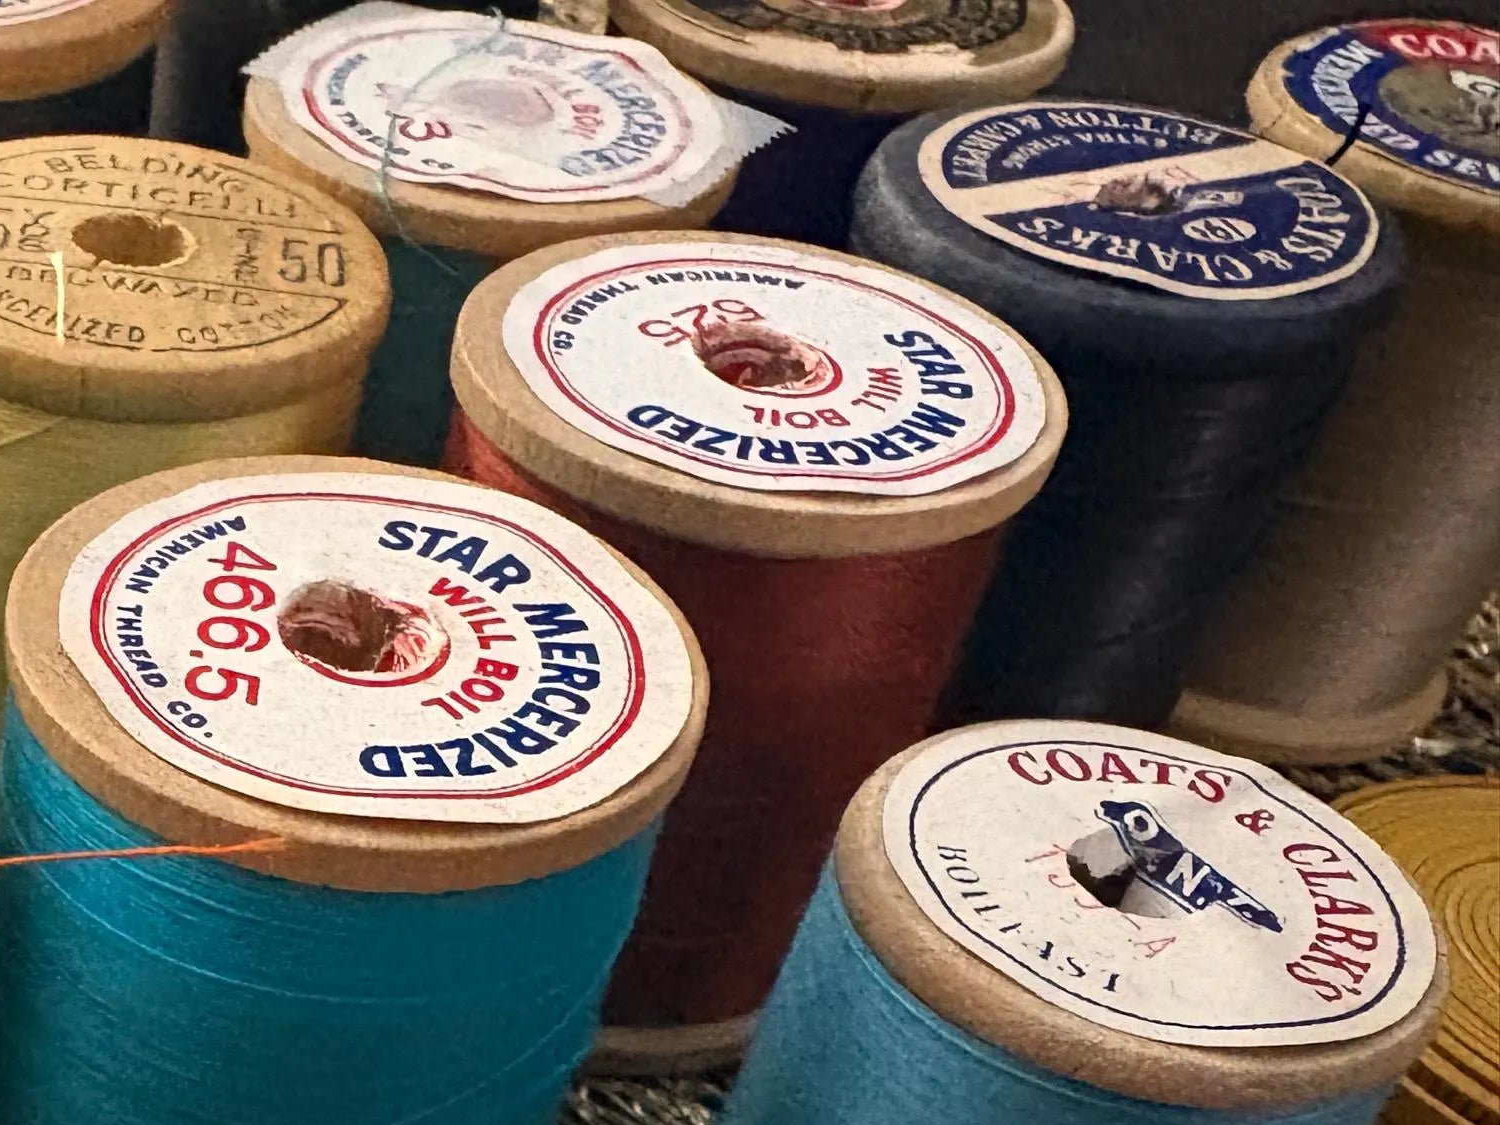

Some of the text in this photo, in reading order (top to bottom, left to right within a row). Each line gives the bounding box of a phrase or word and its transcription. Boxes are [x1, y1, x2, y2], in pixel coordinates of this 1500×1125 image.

[45, 154, 246, 197] BELDING
[1275, 177, 1351, 262] COATS
[277, 237, 348, 288] 50
[562, 281, 641, 326] THREAD
[1017, 217, 1255, 283] CLARK'S
[625, 329, 974, 467] STAR MERCERIZED
[742, 366, 903, 431] WILL BOIL
[116, 514, 248, 739] AMERICAN THREAD CO.
[183, 540, 279, 707] 466.5
[358, 519, 601, 780] STAR MERCERIZED
[421, 576, 520, 721] WILL BOIL
[1007, 749, 1381, 1003] COATS & CLARK'S
